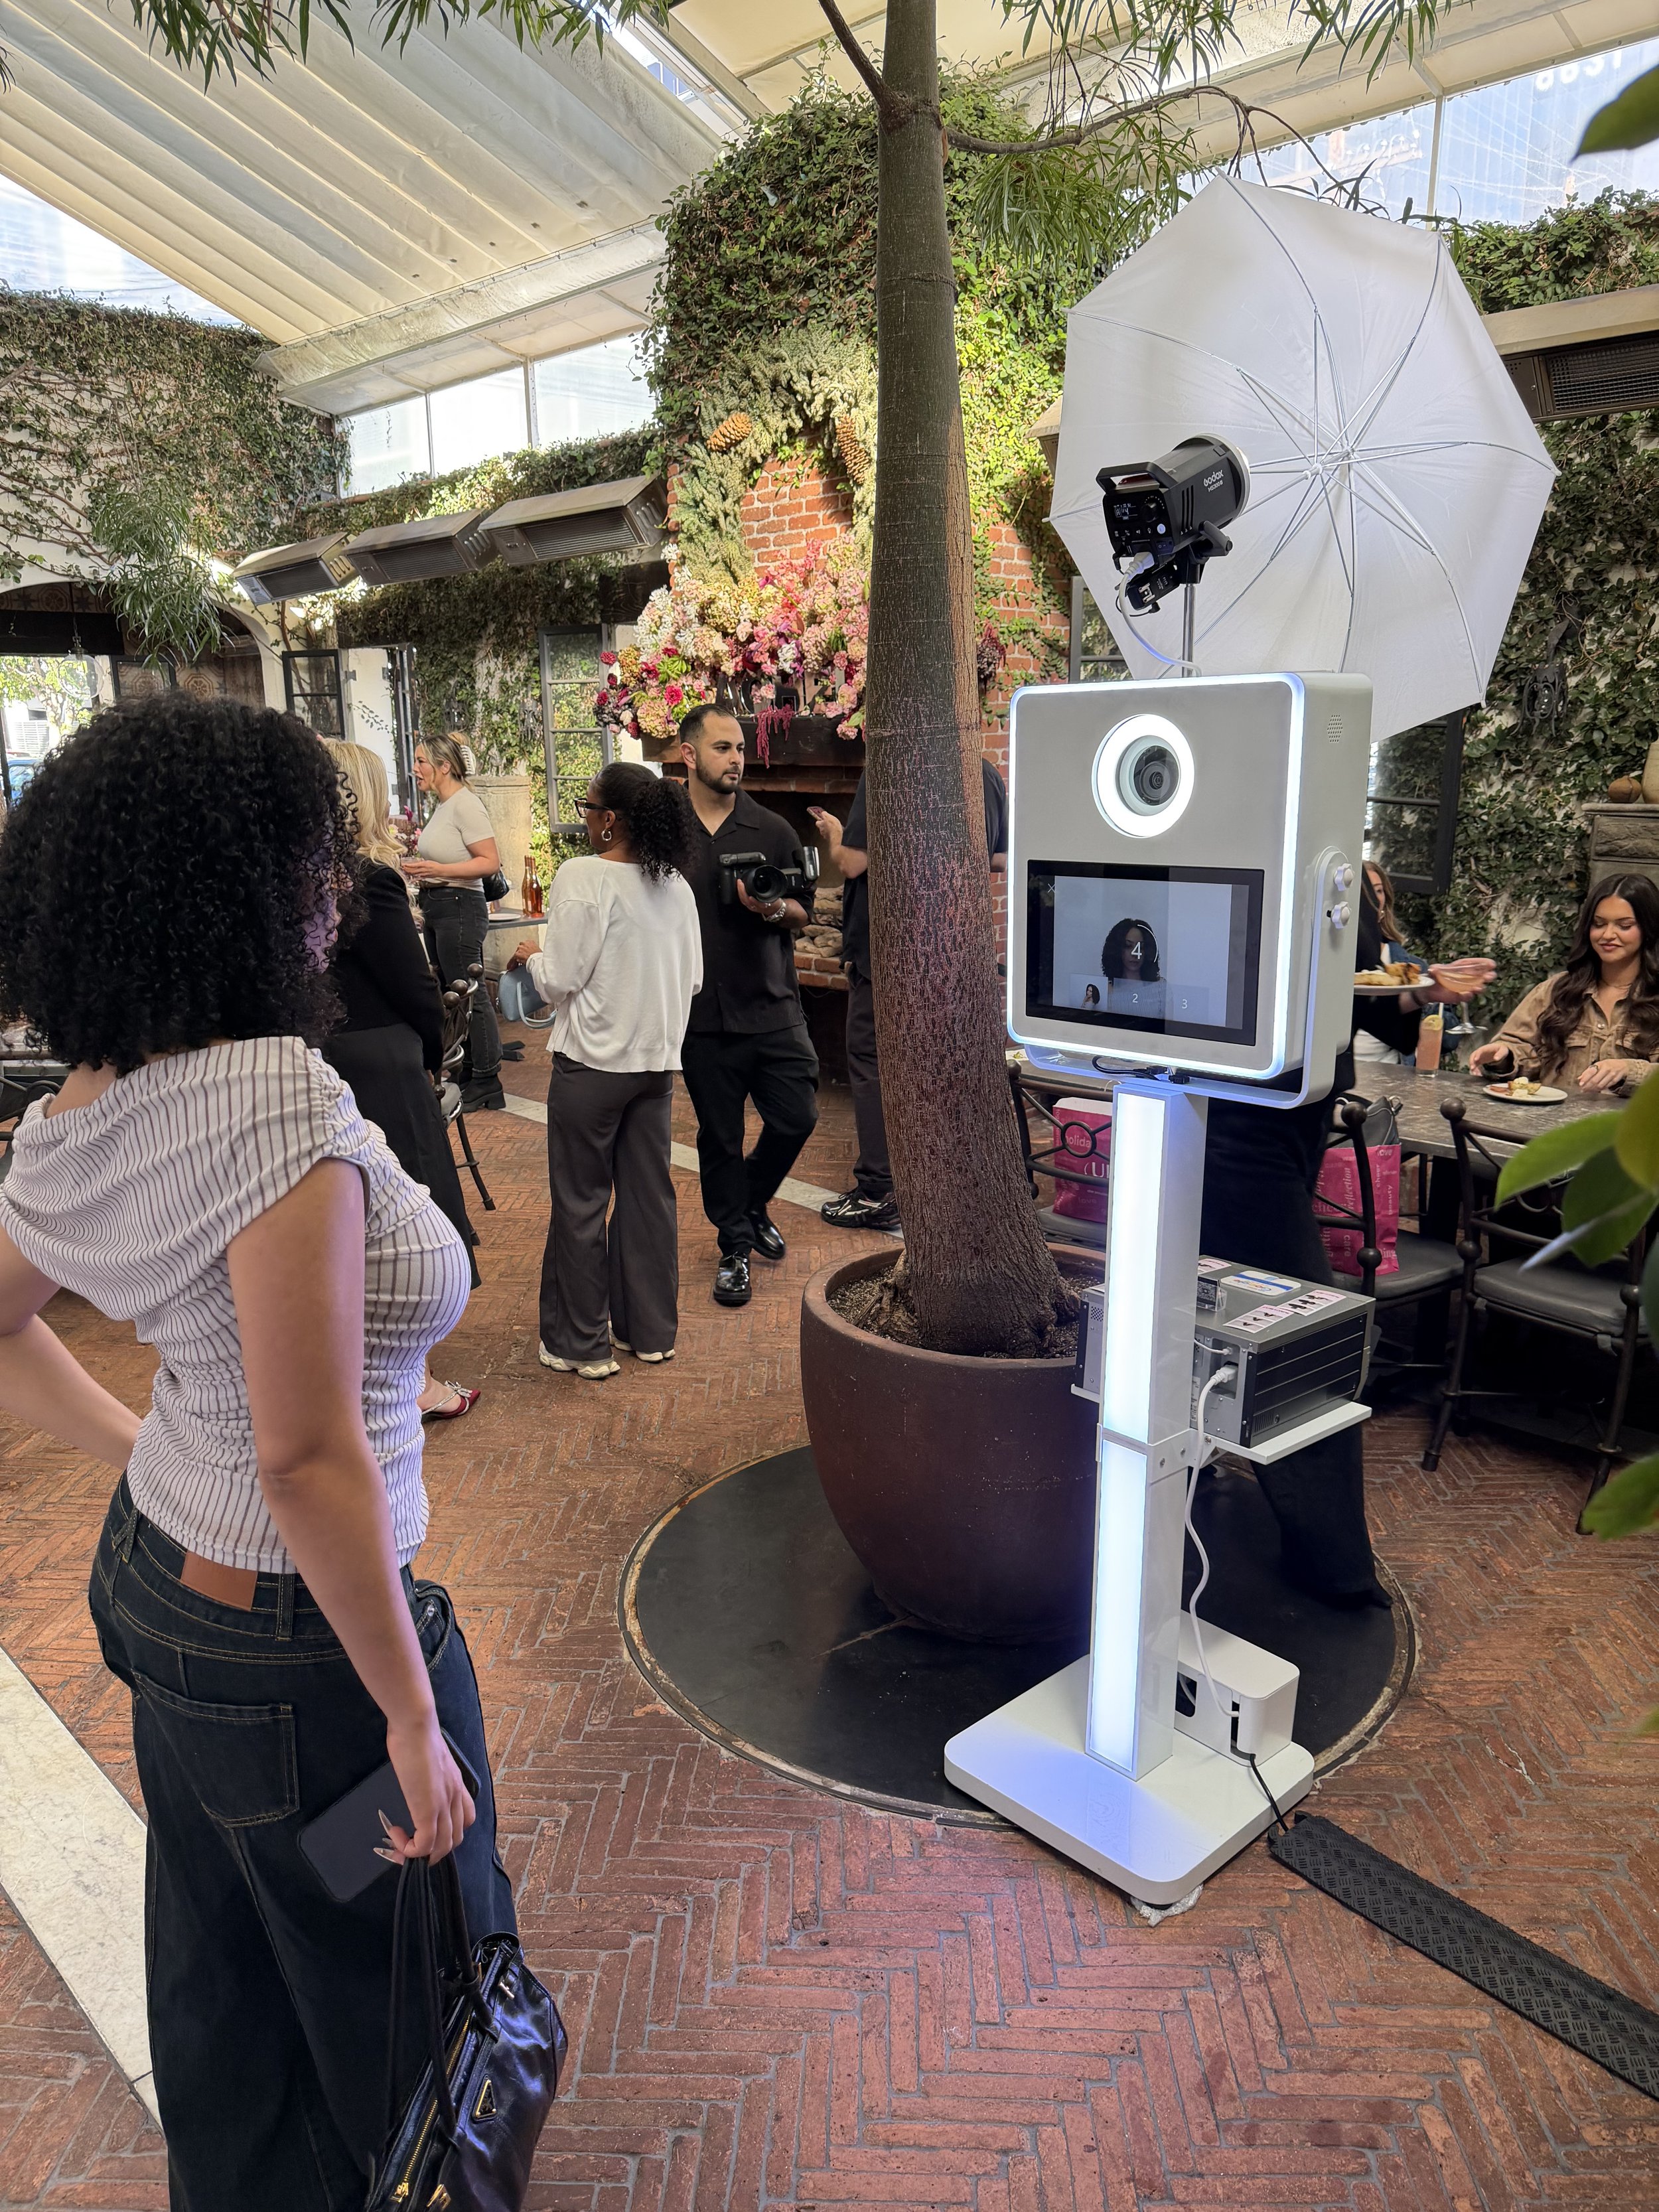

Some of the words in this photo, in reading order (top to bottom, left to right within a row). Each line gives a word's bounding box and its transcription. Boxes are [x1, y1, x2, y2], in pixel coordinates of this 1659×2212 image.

[1203, 469, 1224, 487] Godox
[1131, 941, 1142, 959] 4
[1132, 993, 1138, 1003] 2
[1181, 999, 1188, 1009] 3
